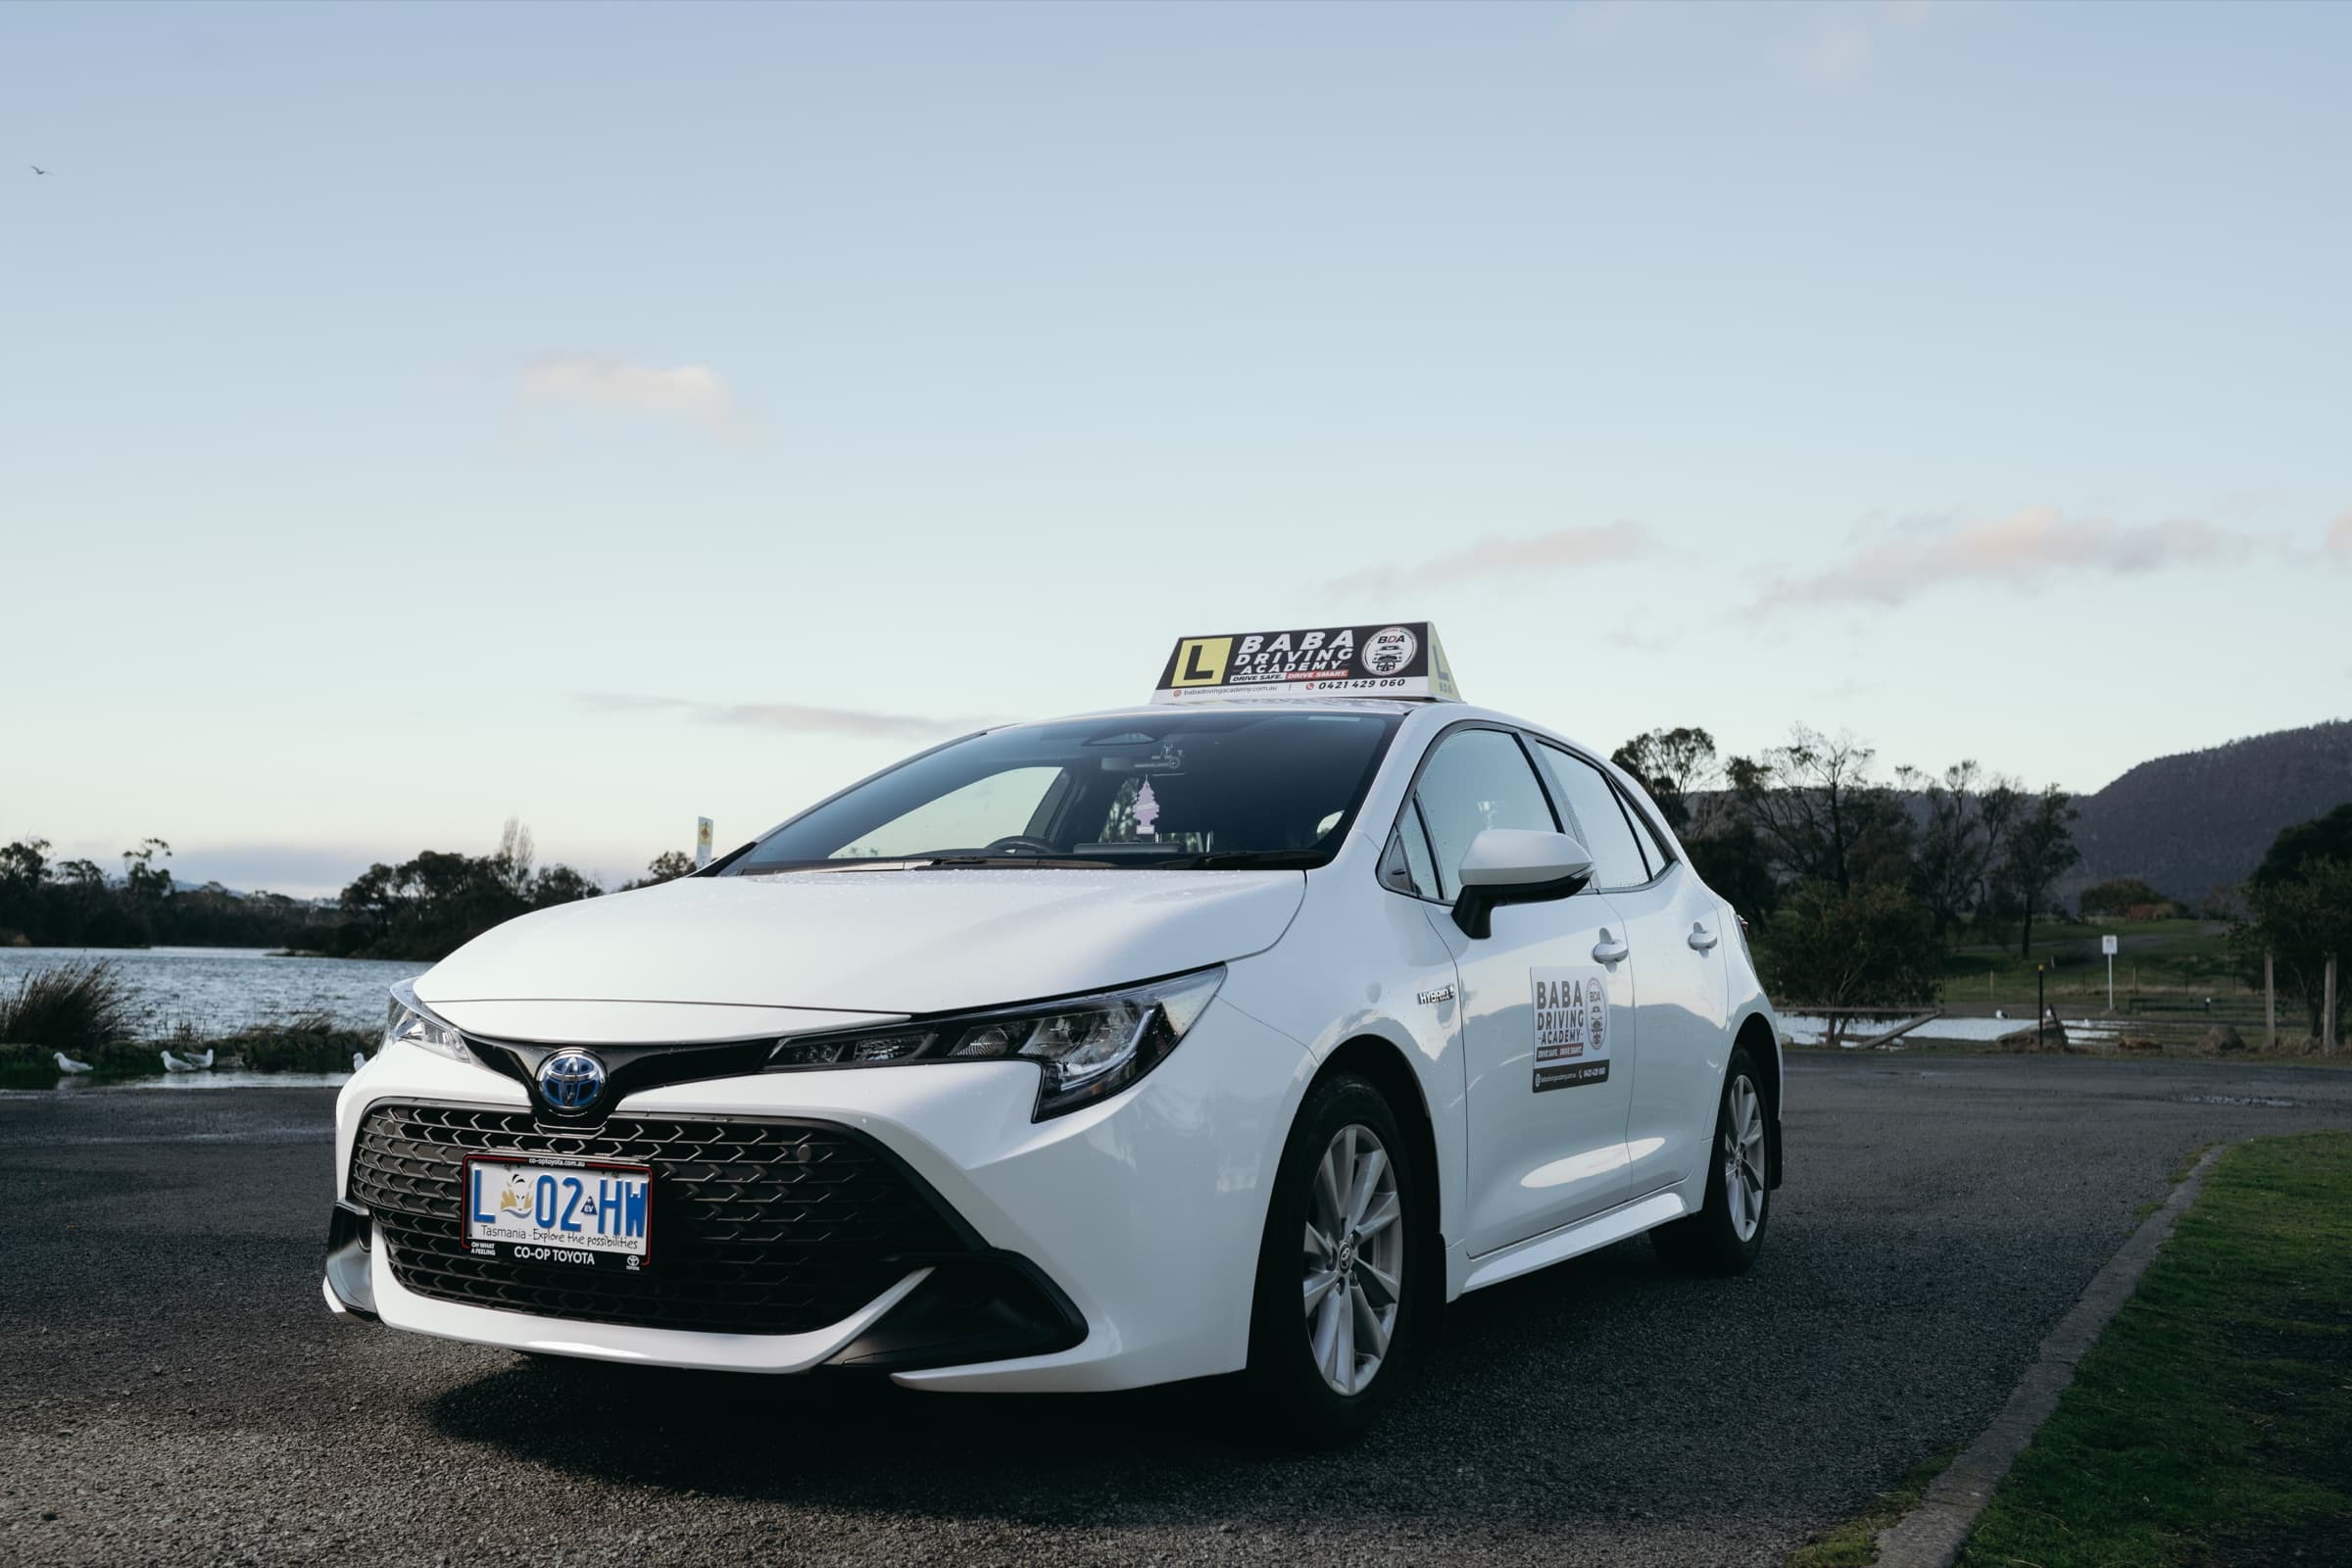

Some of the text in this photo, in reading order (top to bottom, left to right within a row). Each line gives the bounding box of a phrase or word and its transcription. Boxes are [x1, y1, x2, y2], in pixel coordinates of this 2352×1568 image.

[1238, 629, 1354, 654] BABA
[1378, 635, 1405, 644] BDA
[1183, 645, 1214, 680] L
[1235, 648, 1354, 666] DRIVING
[1240, 661, 1343, 674] ACADEMY
[1318, 678, 1406, 690] 0421 429 060
[1537, 980, 1583, 1009] BABA
[1537, 1009, 1584, 1031] DRIVING
[529, 1158, 585, 1167] co-optoyota.com.au
[472, 1167, 650, 1238] L 02 HW
[481, 1225, 526, 1240] Tasmania
[532, 1228, 565, 1246] Explore
[567, 1231, 586, 1245] the
[587, 1234, 639, 1250] possibilities
[514, 1246, 596, 1265] CO-OP TOYOTA
